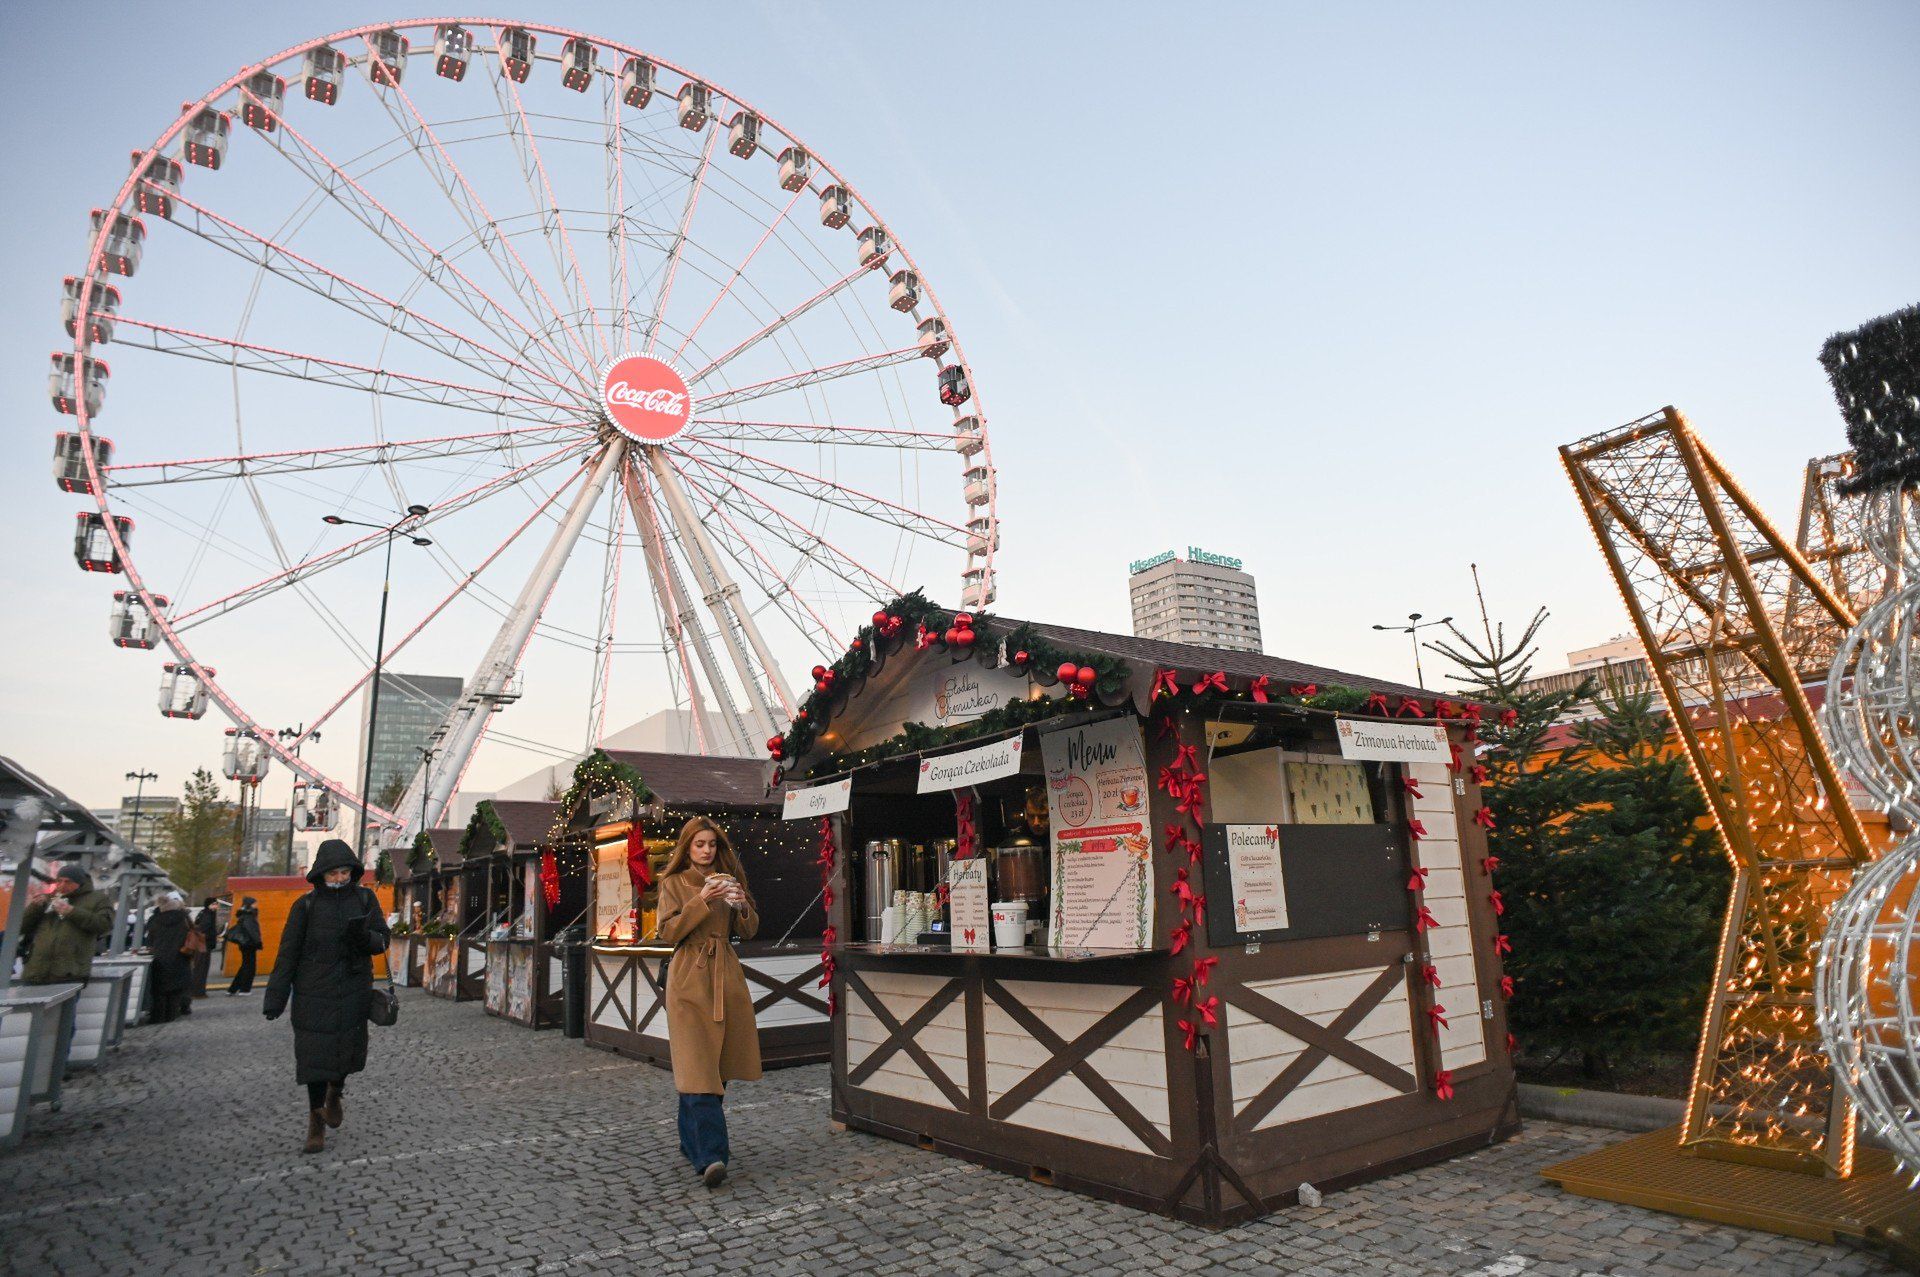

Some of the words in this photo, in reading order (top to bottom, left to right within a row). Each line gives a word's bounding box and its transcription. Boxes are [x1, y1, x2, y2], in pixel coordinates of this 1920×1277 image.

[1129, 549, 1175, 573] Hisense
[1188, 546, 1243, 567] Hisense
[1068, 730, 1117, 771] Menu
[1354, 731, 1397, 749] Zimowa
[1398, 734, 1437, 751] Herbata
[930, 765, 963, 781] Gorąca
[964, 750, 1009, 775] Czekolada
[810, 794, 826, 811] Gofry
[1103, 790, 1111, 798] 20
[1231, 831, 1276, 849] Polecamy
